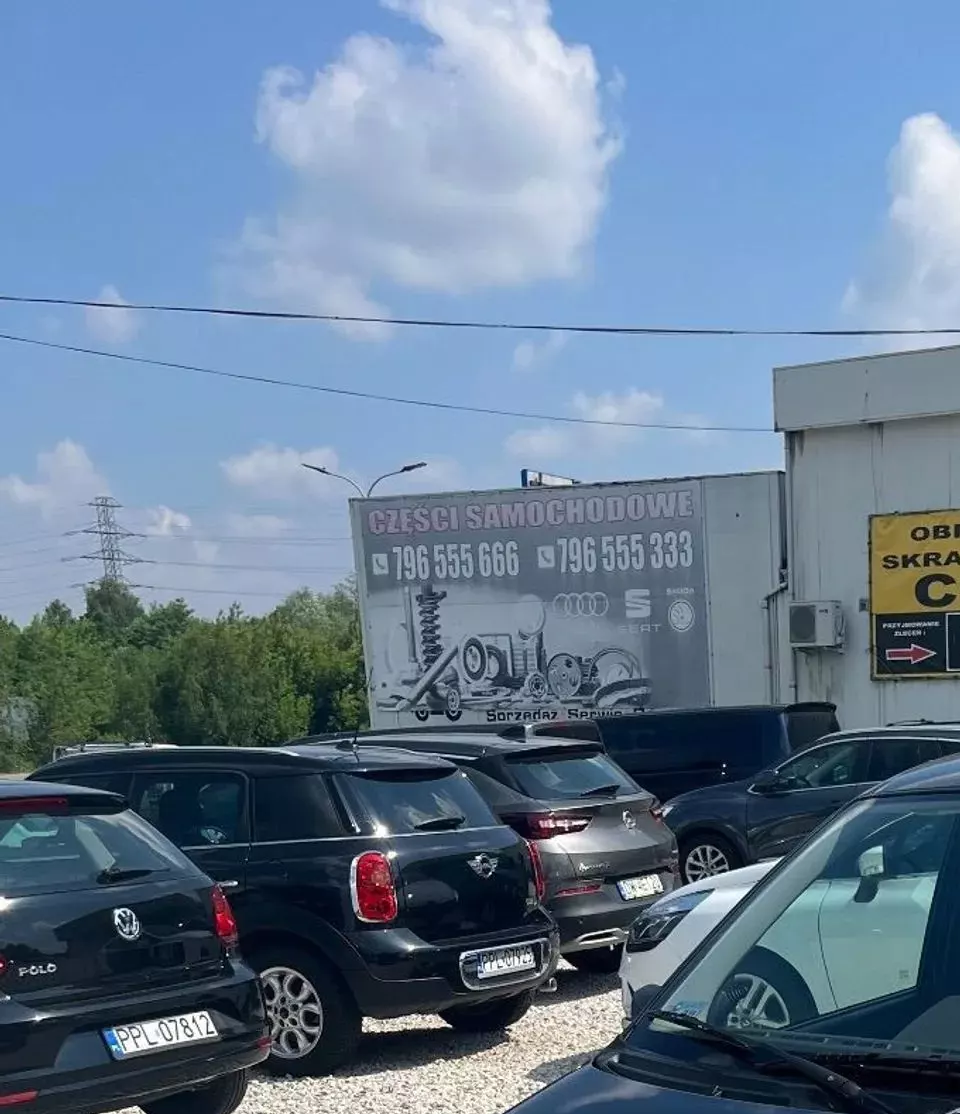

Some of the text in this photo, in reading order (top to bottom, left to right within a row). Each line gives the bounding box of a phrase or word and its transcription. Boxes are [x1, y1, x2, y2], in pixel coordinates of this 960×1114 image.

[368, 490, 693, 535] CZĘŚCI SAMOCHODOWE
[392, 540, 519, 581] 796 555 666
[557, 530, 693, 574] 796 555 333
[19, 963, 57, 977] POLO
[116, 1014, 215, 1052] PPL 07812
